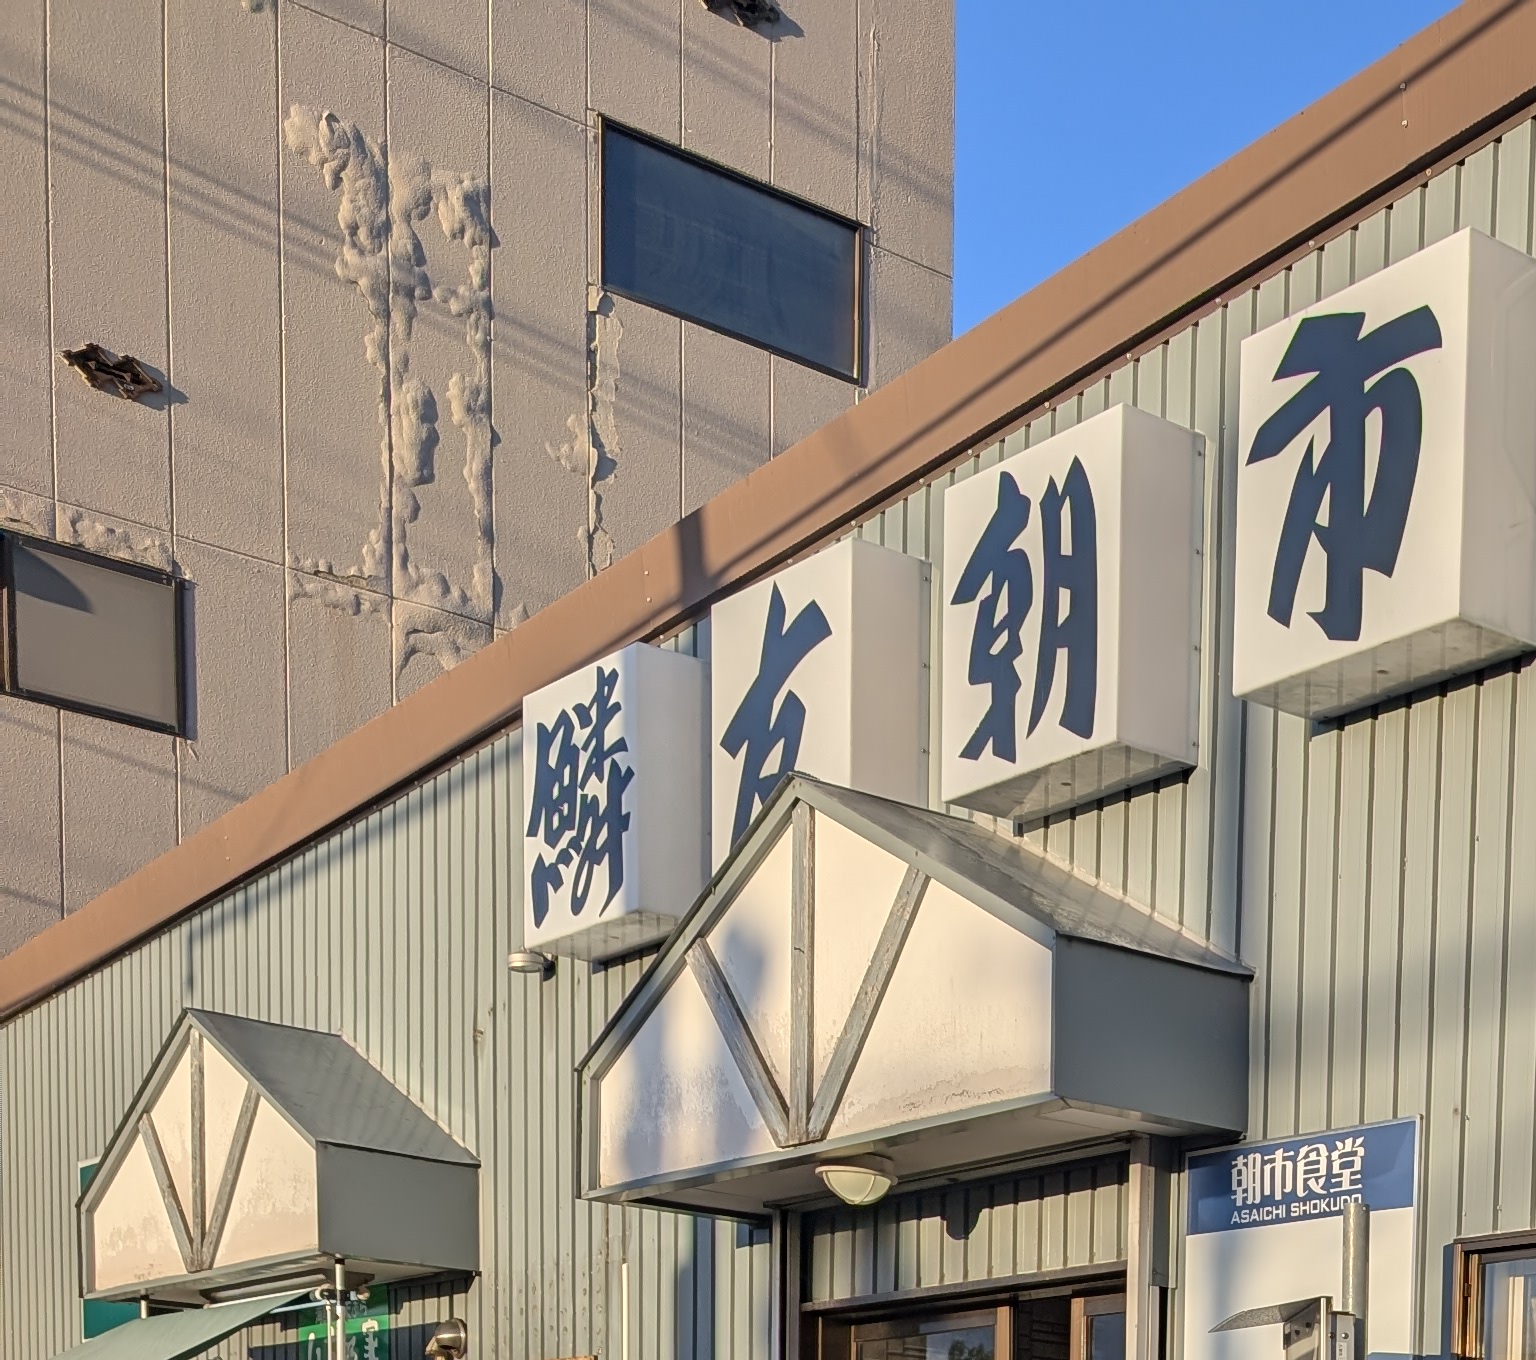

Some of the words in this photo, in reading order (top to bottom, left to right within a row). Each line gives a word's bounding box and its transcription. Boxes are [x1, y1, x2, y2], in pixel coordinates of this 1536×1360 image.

[1230, 1136, 1365, 1207] 朝市食堂
[1230, 1204, 1286, 1224] ASAICHI
